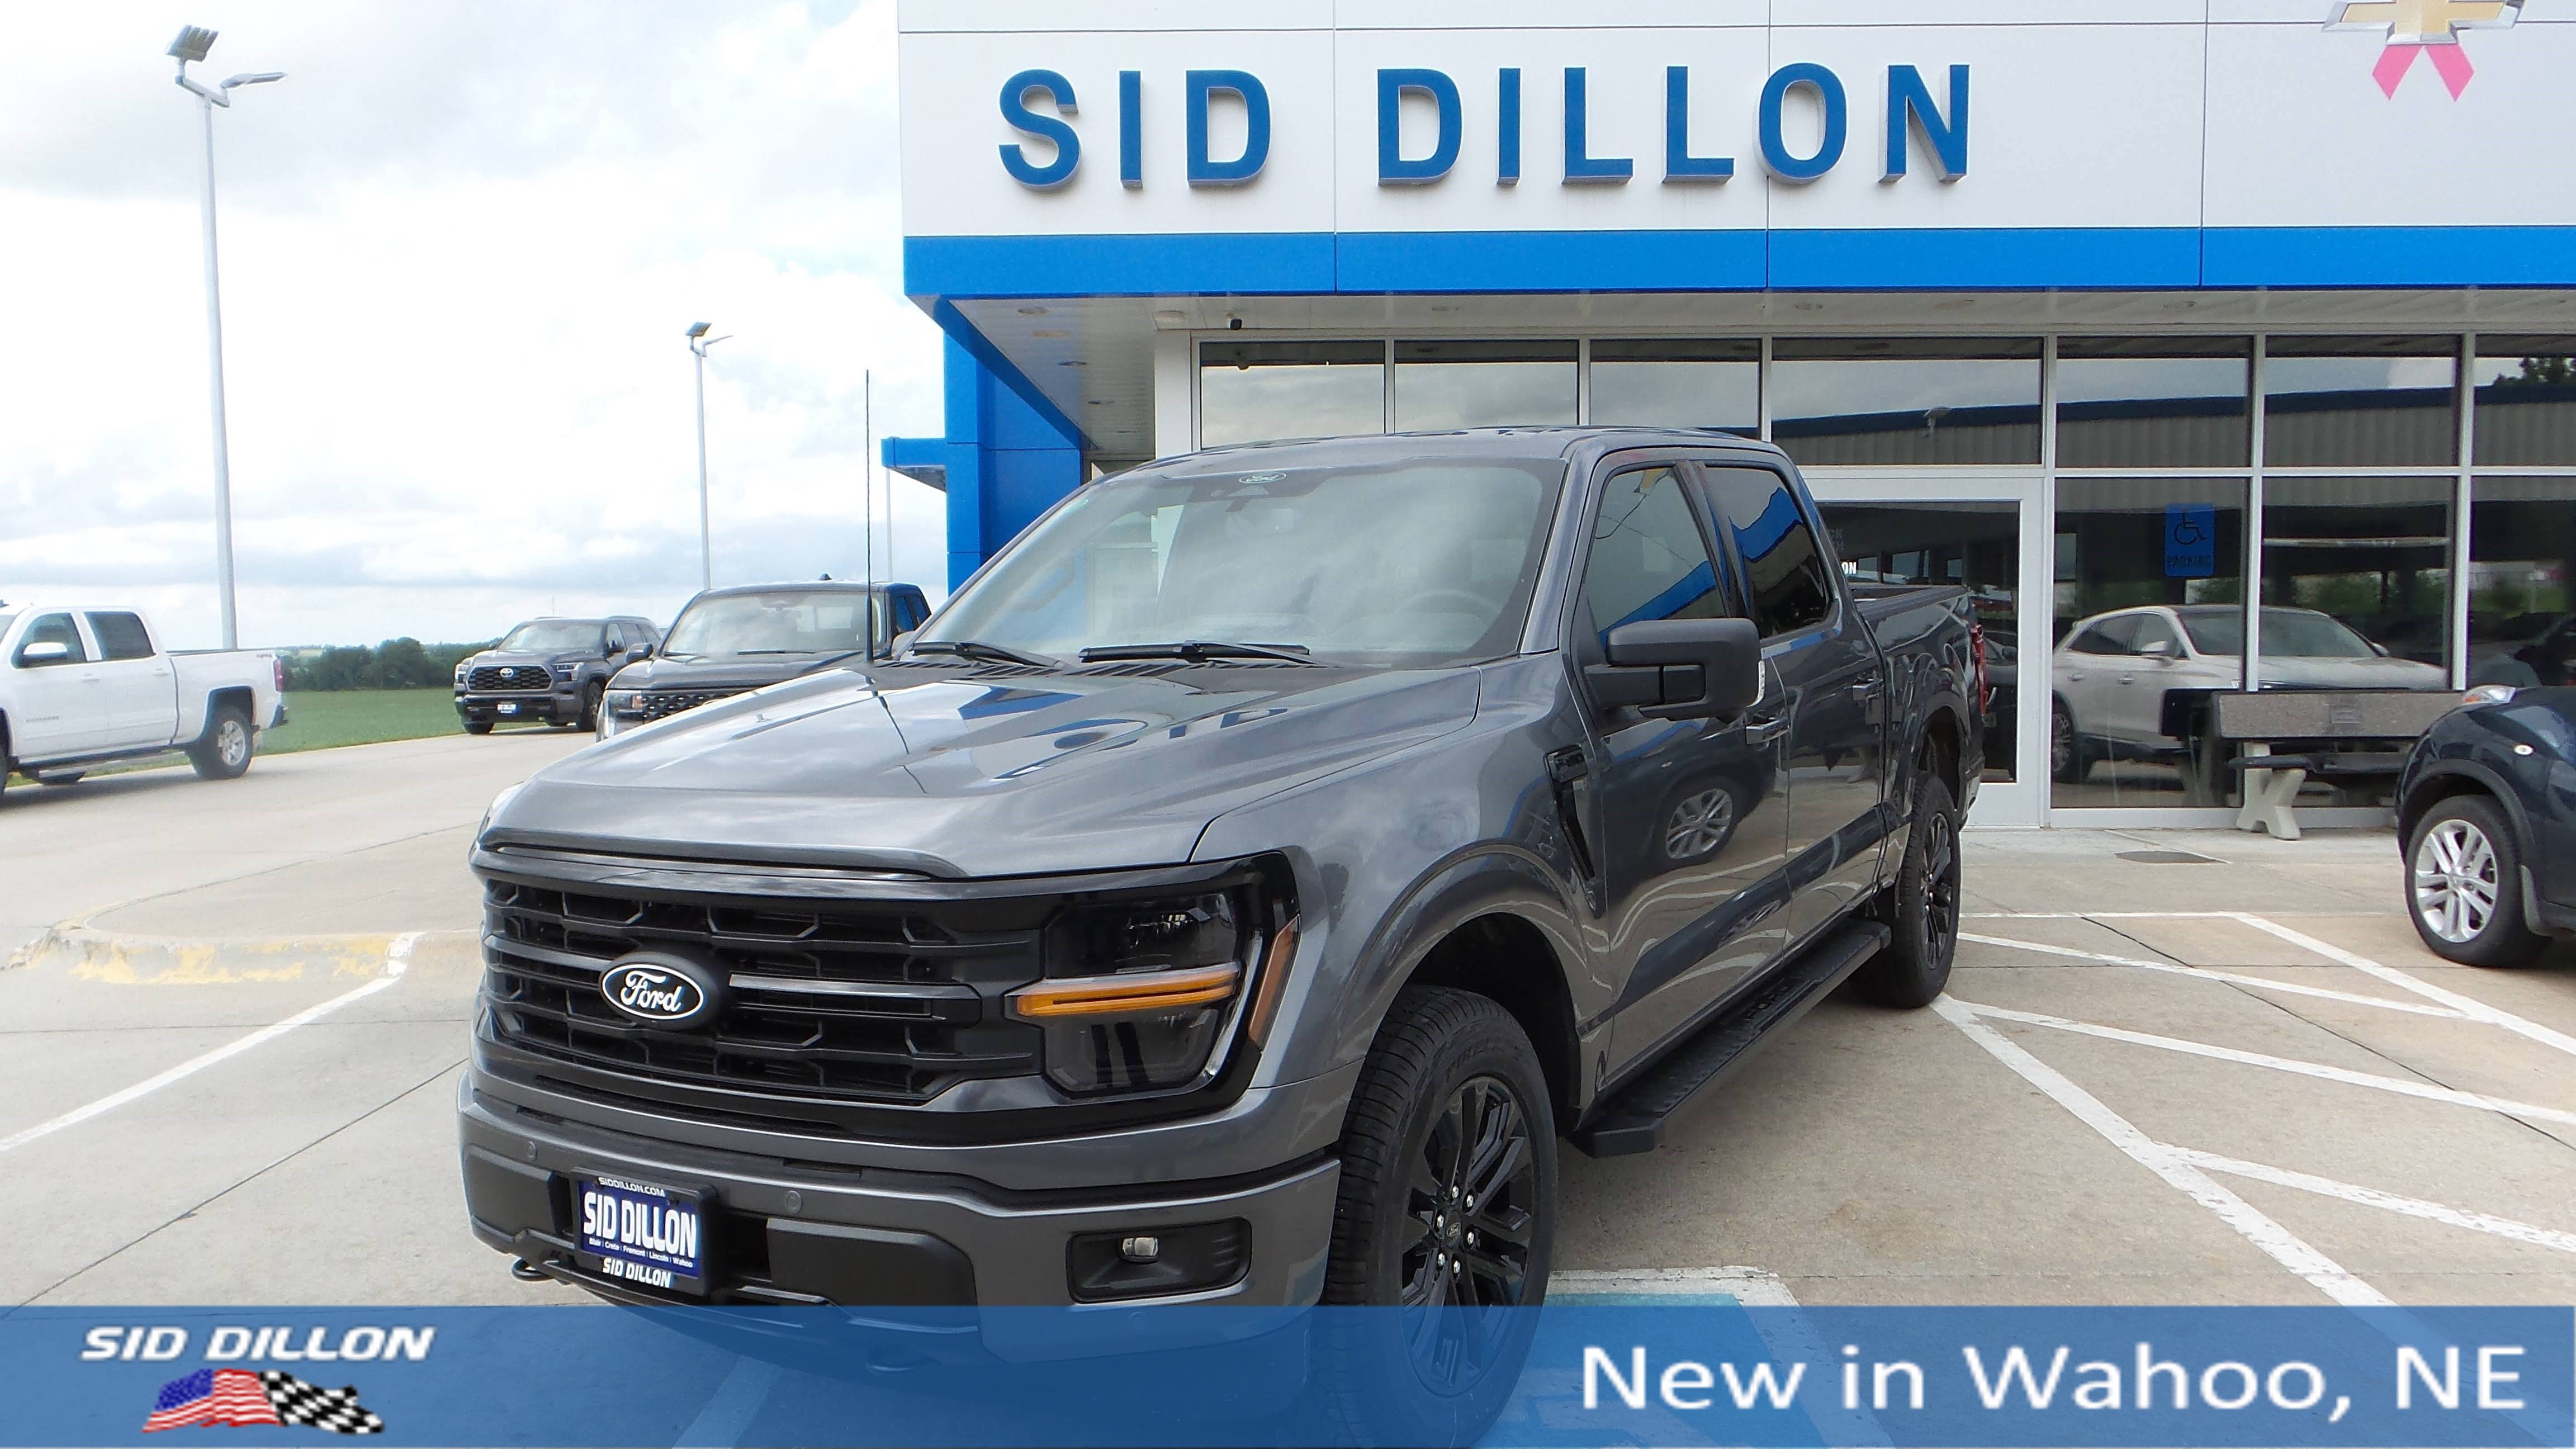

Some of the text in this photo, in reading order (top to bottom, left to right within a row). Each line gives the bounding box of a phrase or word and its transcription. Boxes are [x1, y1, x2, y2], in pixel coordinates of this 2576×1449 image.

[998, 63, 1970, 188] SID DILLON
[620, 970, 682, 1012] Ford
[598, 1176, 666, 1197] SIDDILLON.COM
[583, 1191, 697, 1258] SID DILLON
[603, 1257, 671, 1288] SID DILLON
[604, 1241, 620, 1251] Crete
[623, 1245, 646, 1257] Fremont
[649, 1251, 669, 1262] Lincoln
[673, 1257, 693, 1268] Wahoo
